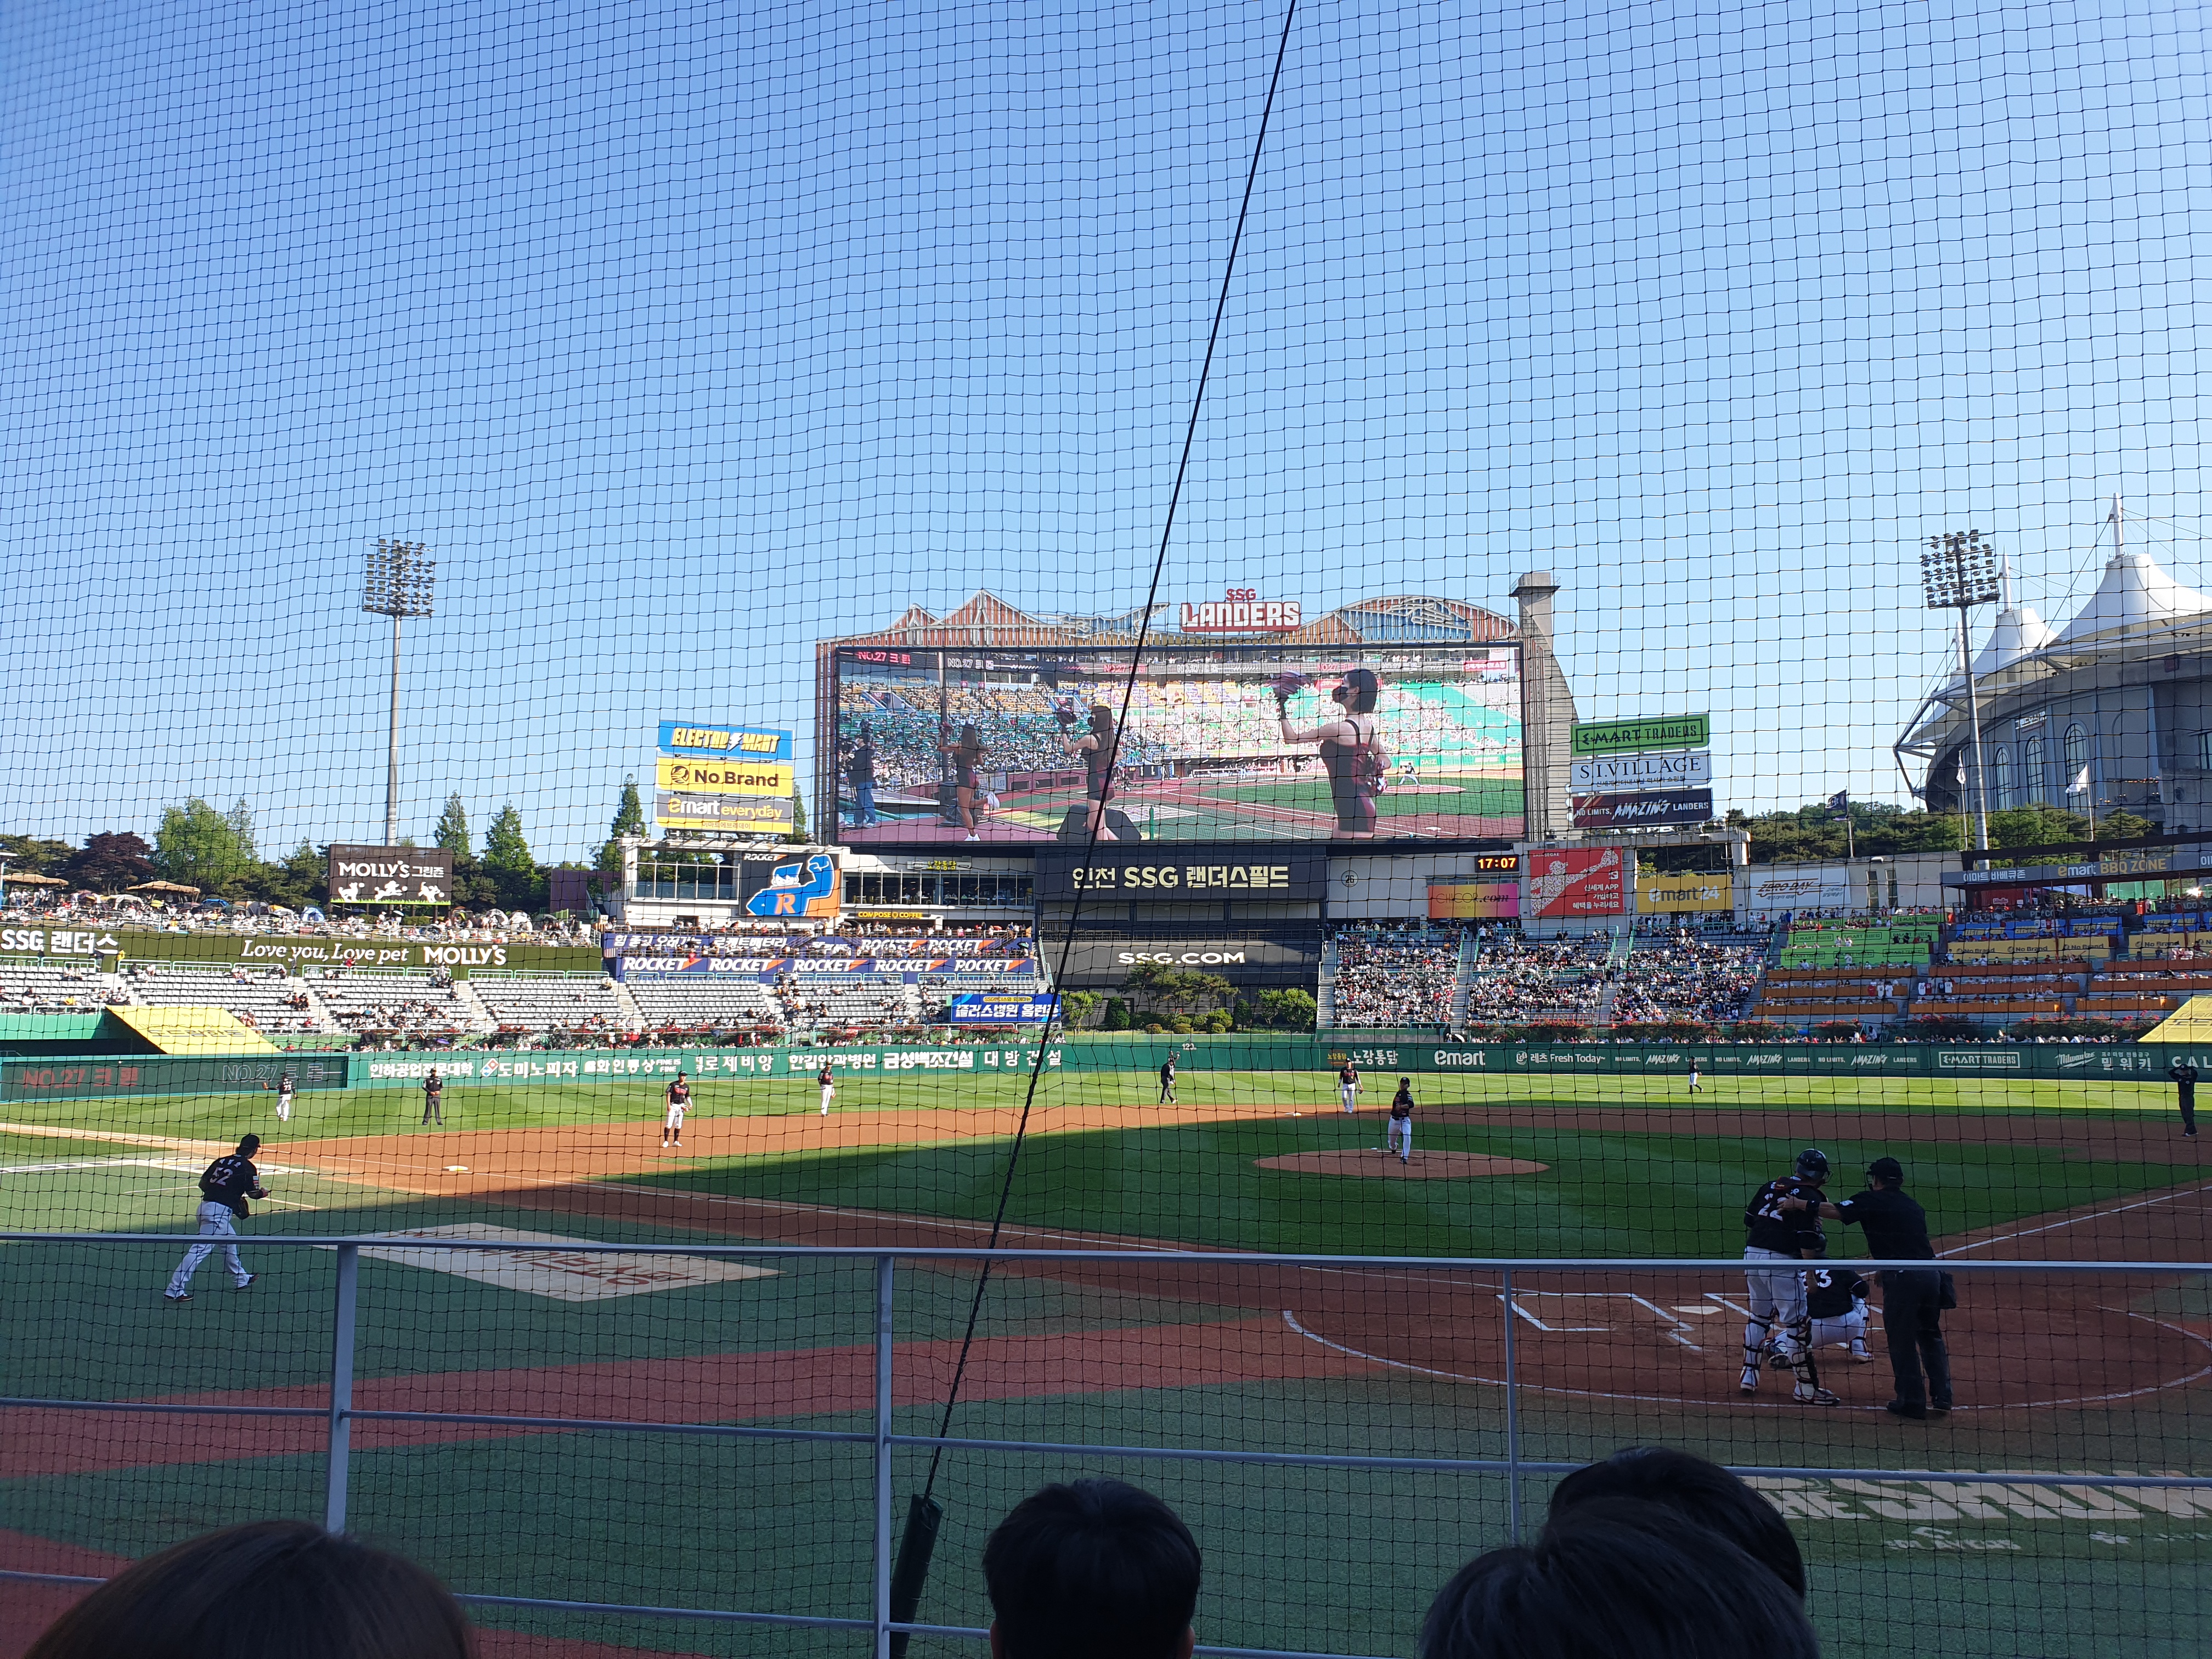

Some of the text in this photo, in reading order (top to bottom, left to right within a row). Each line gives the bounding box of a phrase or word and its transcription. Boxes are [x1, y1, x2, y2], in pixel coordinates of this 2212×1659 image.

[1226, 588, 1256, 601] SSG
[1182, 602, 1300, 627] LANDERS
[1645, 725, 1696, 740] TRADERS
[672, 727, 781, 754] ELECTRO MART
[1580, 758, 1701, 778] S.I.VILLAGE
[694, 769, 779, 787] No Brand
[668, 798, 783, 820] emart everyday
[1576, 808, 1585, 816] NO
[1611, 799, 1671, 820] AMAZING
[1673, 802, 1709, 811] LANDERS
[743, 853, 779, 862] ROCKET
[1477, 857, 1516, 869] 17:07
[338, 860, 444, 878] MOLLY'S 그린존
[1963, 858, 2166, 882] 이마트 바베큐존 emart BBQ ZONE
[1073, 866, 1289, 888] 인천 SSG 랜더스필드
[1345, 875, 1355, 883] 26
[1758, 882, 1814, 891] ZERO DAY
[775, 893, 795, 914] R
[1, 929, 119, 954] SSG 랜더스
[614, 935, 625, 947] 힘
[928, 939, 981, 951] ROCKET
[241, 940, 506, 965] Love you, Love pet MOLLY'S
[1118, 951, 1245, 964] SSG.COM
[623, 957, 688, 971] ROCKET
[709, 958, 773, 972] ROCKET
[793, 959, 854, 972] ROCKET
[874, 959, 935, 972] ROCKET
[955, 959, 1014, 972] ROCKET
[789, 1054, 876, 1070] 한길안과병원
[883, 1051, 973, 1069] 금성백조건설
[1352, 1049, 1486, 1066] 노랑통닭 emart
[1531, 1053, 1548, 1063] 레츠
[1551, 1053, 1573, 1063] Fresh
[1646, 1054, 1680, 1065] AMAZING
[1746, 1054, 1783, 1066] AMAZING
[1850, 1054, 1888, 1066] AMAZING
[1983, 1055, 2016, 1064] TRADERS
[2055, 1051, 2096, 1065] Milwaukee
[222, 1064, 278, 1083] NO.27
[370, 1062, 473, 1077] 인하공업전문대학
[498, 1061, 578, 1078] 도미노피자
[23, 1068, 85, 1089] NO.27
[210, 1167, 233, 1186] 52
